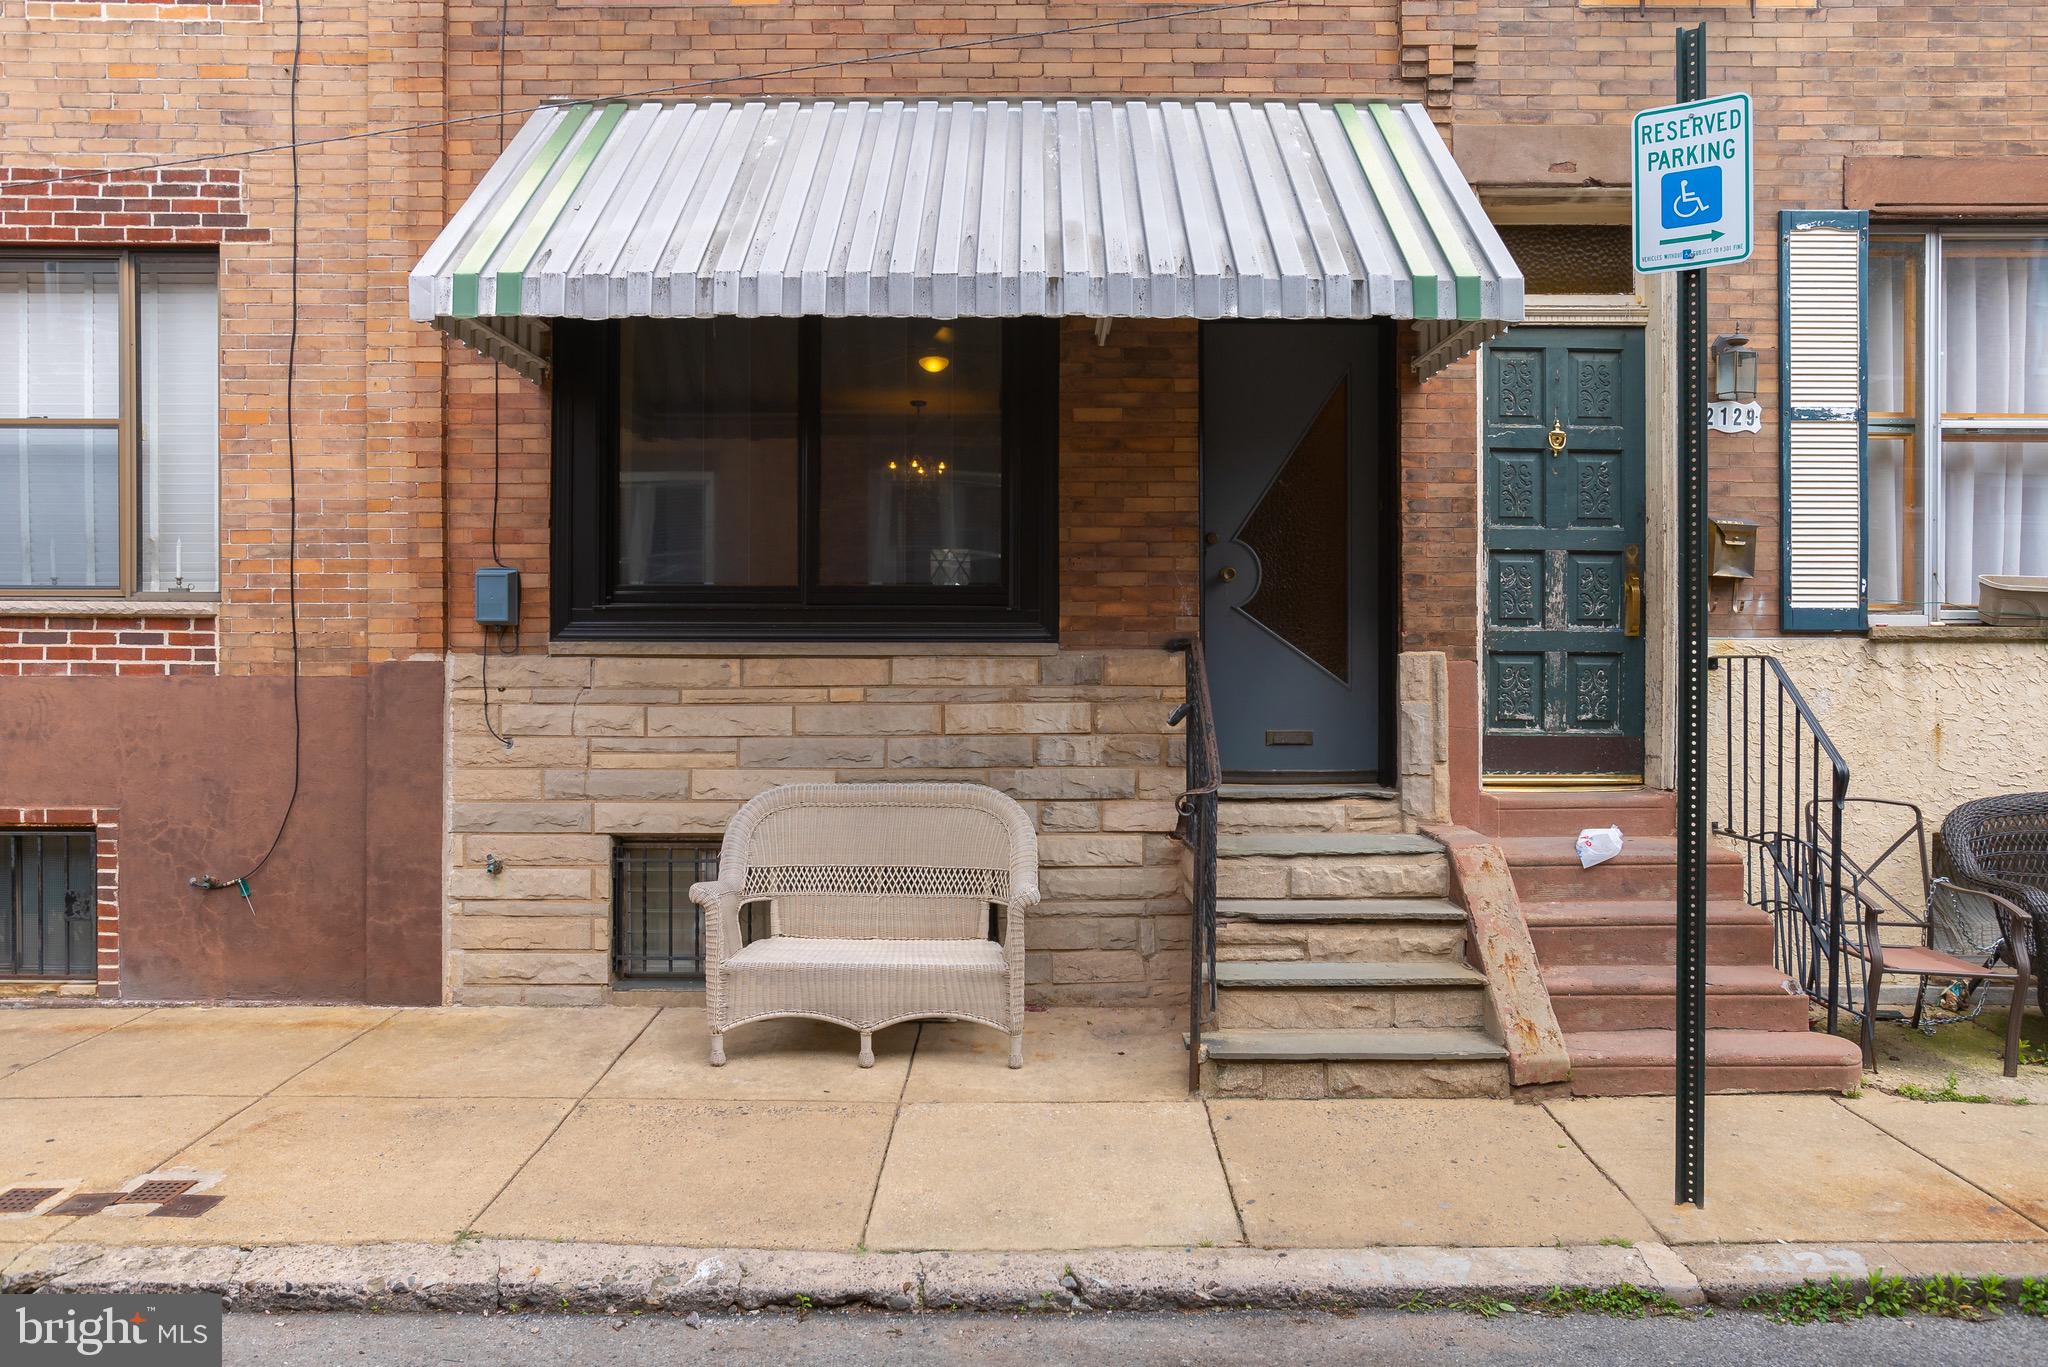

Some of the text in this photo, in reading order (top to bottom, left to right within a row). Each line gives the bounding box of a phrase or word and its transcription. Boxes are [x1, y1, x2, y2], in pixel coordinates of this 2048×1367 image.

[1642, 109, 1741, 145] RESERVED
[1648, 138, 1735, 171] PARKING
[1641, 254, 1662, 262] VEHICLES
[1707, 407, 1755, 426] 2129
